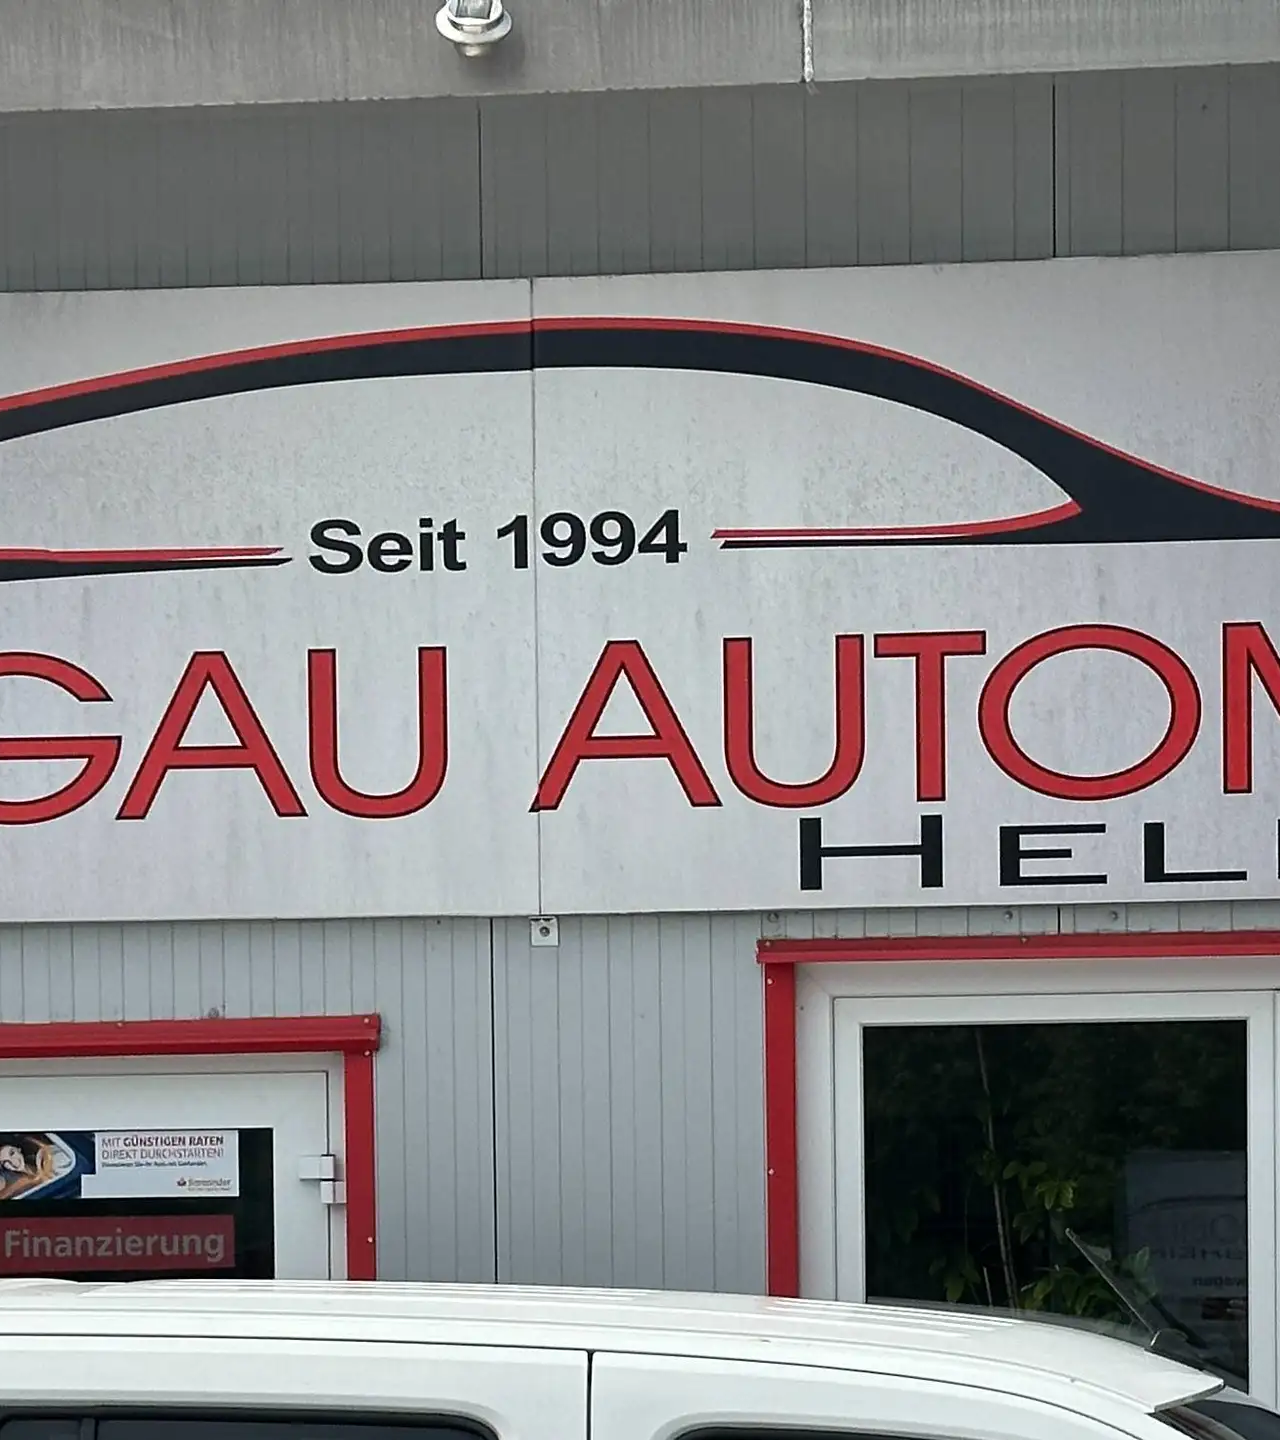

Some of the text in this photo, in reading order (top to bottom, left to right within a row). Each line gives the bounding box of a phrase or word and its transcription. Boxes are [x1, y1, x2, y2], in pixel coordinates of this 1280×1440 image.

[308, 509, 688, 575] Seit 1994
[101, 1134, 224, 1148] MIT GÜNSTIGEN RATEN
[101, 1149, 138, 1160] DIREKT
[4, 1227, 225, 1263] Finanzierung
